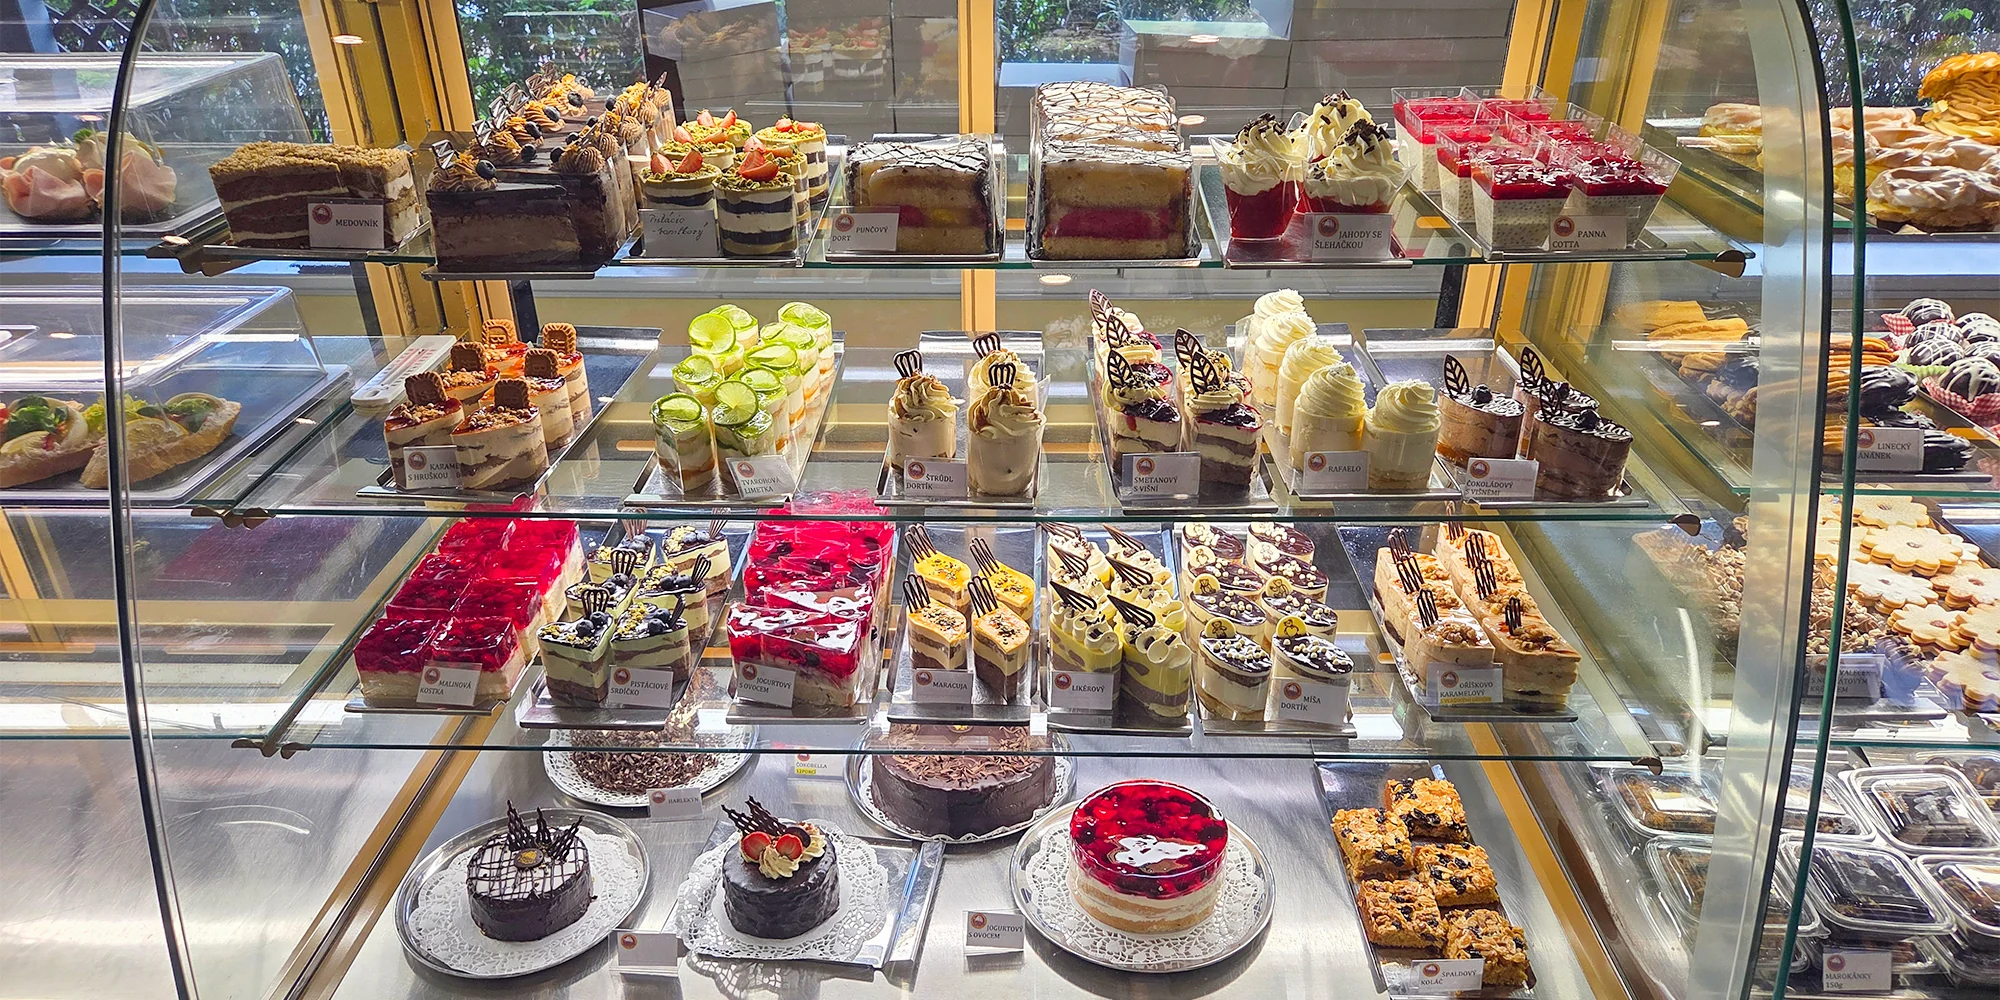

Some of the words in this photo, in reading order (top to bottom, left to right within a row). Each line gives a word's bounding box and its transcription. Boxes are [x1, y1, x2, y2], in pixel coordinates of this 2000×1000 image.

[335, 218, 379, 228] MEDOVNÍK
[856, 226, 889, 234] PUNČOVÝ
[1577, 230, 1607, 238] PANNA
[1338, 231, 1371, 240] JAHODY
[1372, 231, 1383, 239] SE
[1315, 239, 1364, 249] ŠLEHAČKOU
[1552, 240, 1580, 248] COTTA
[1877, 442, 1912, 450] LINECKÝ
[1857, 451, 1892, 459] ANÁNEK
[1328, 465, 1361, 473] RAFAELO
[413, 472, 449, 481] HRUŠKOU
[1134, 476, 1178, 484] SMETANOVÝ
[905, 482, 933, 490] DORTÍK
[1466, 480, 1513, 488] ČOKOLÁDOVÝ
[744, 486, 774, 494] LIMETKA
[1138, 485, 1159, 493] VIŠNÍ
[439, 680, 472, 689] MALINOVÁ
[630, 680, 669, 691] PISTÁCIOVÉ
[756, 677, 792, 690] JOGURTOVÝ
[932, 681, 968, 690] MARACUJA
[1459, 681, 1493, 689] OŘÍŠKOVO
[419, 687, 444, 695] KOSTKA
[610, 687, 640, 696] SRDÍČKO
[743, 683, 769, 694] OVOCEM
[1071, 684, 1105, 693] LIKÉROVÝ
[1440, 689, 1485, 698] KARAMELOVÝ
[1303, 695, 1322, 704] MÍŠA
[1280, 702, 1308, 712] DORTÍK
[986, 924, 1023, 933] JOGURTOVÝ
[1420, 978, 1443, 986] KOLÁČ
[1826, 981, 1843, 989] 150g
